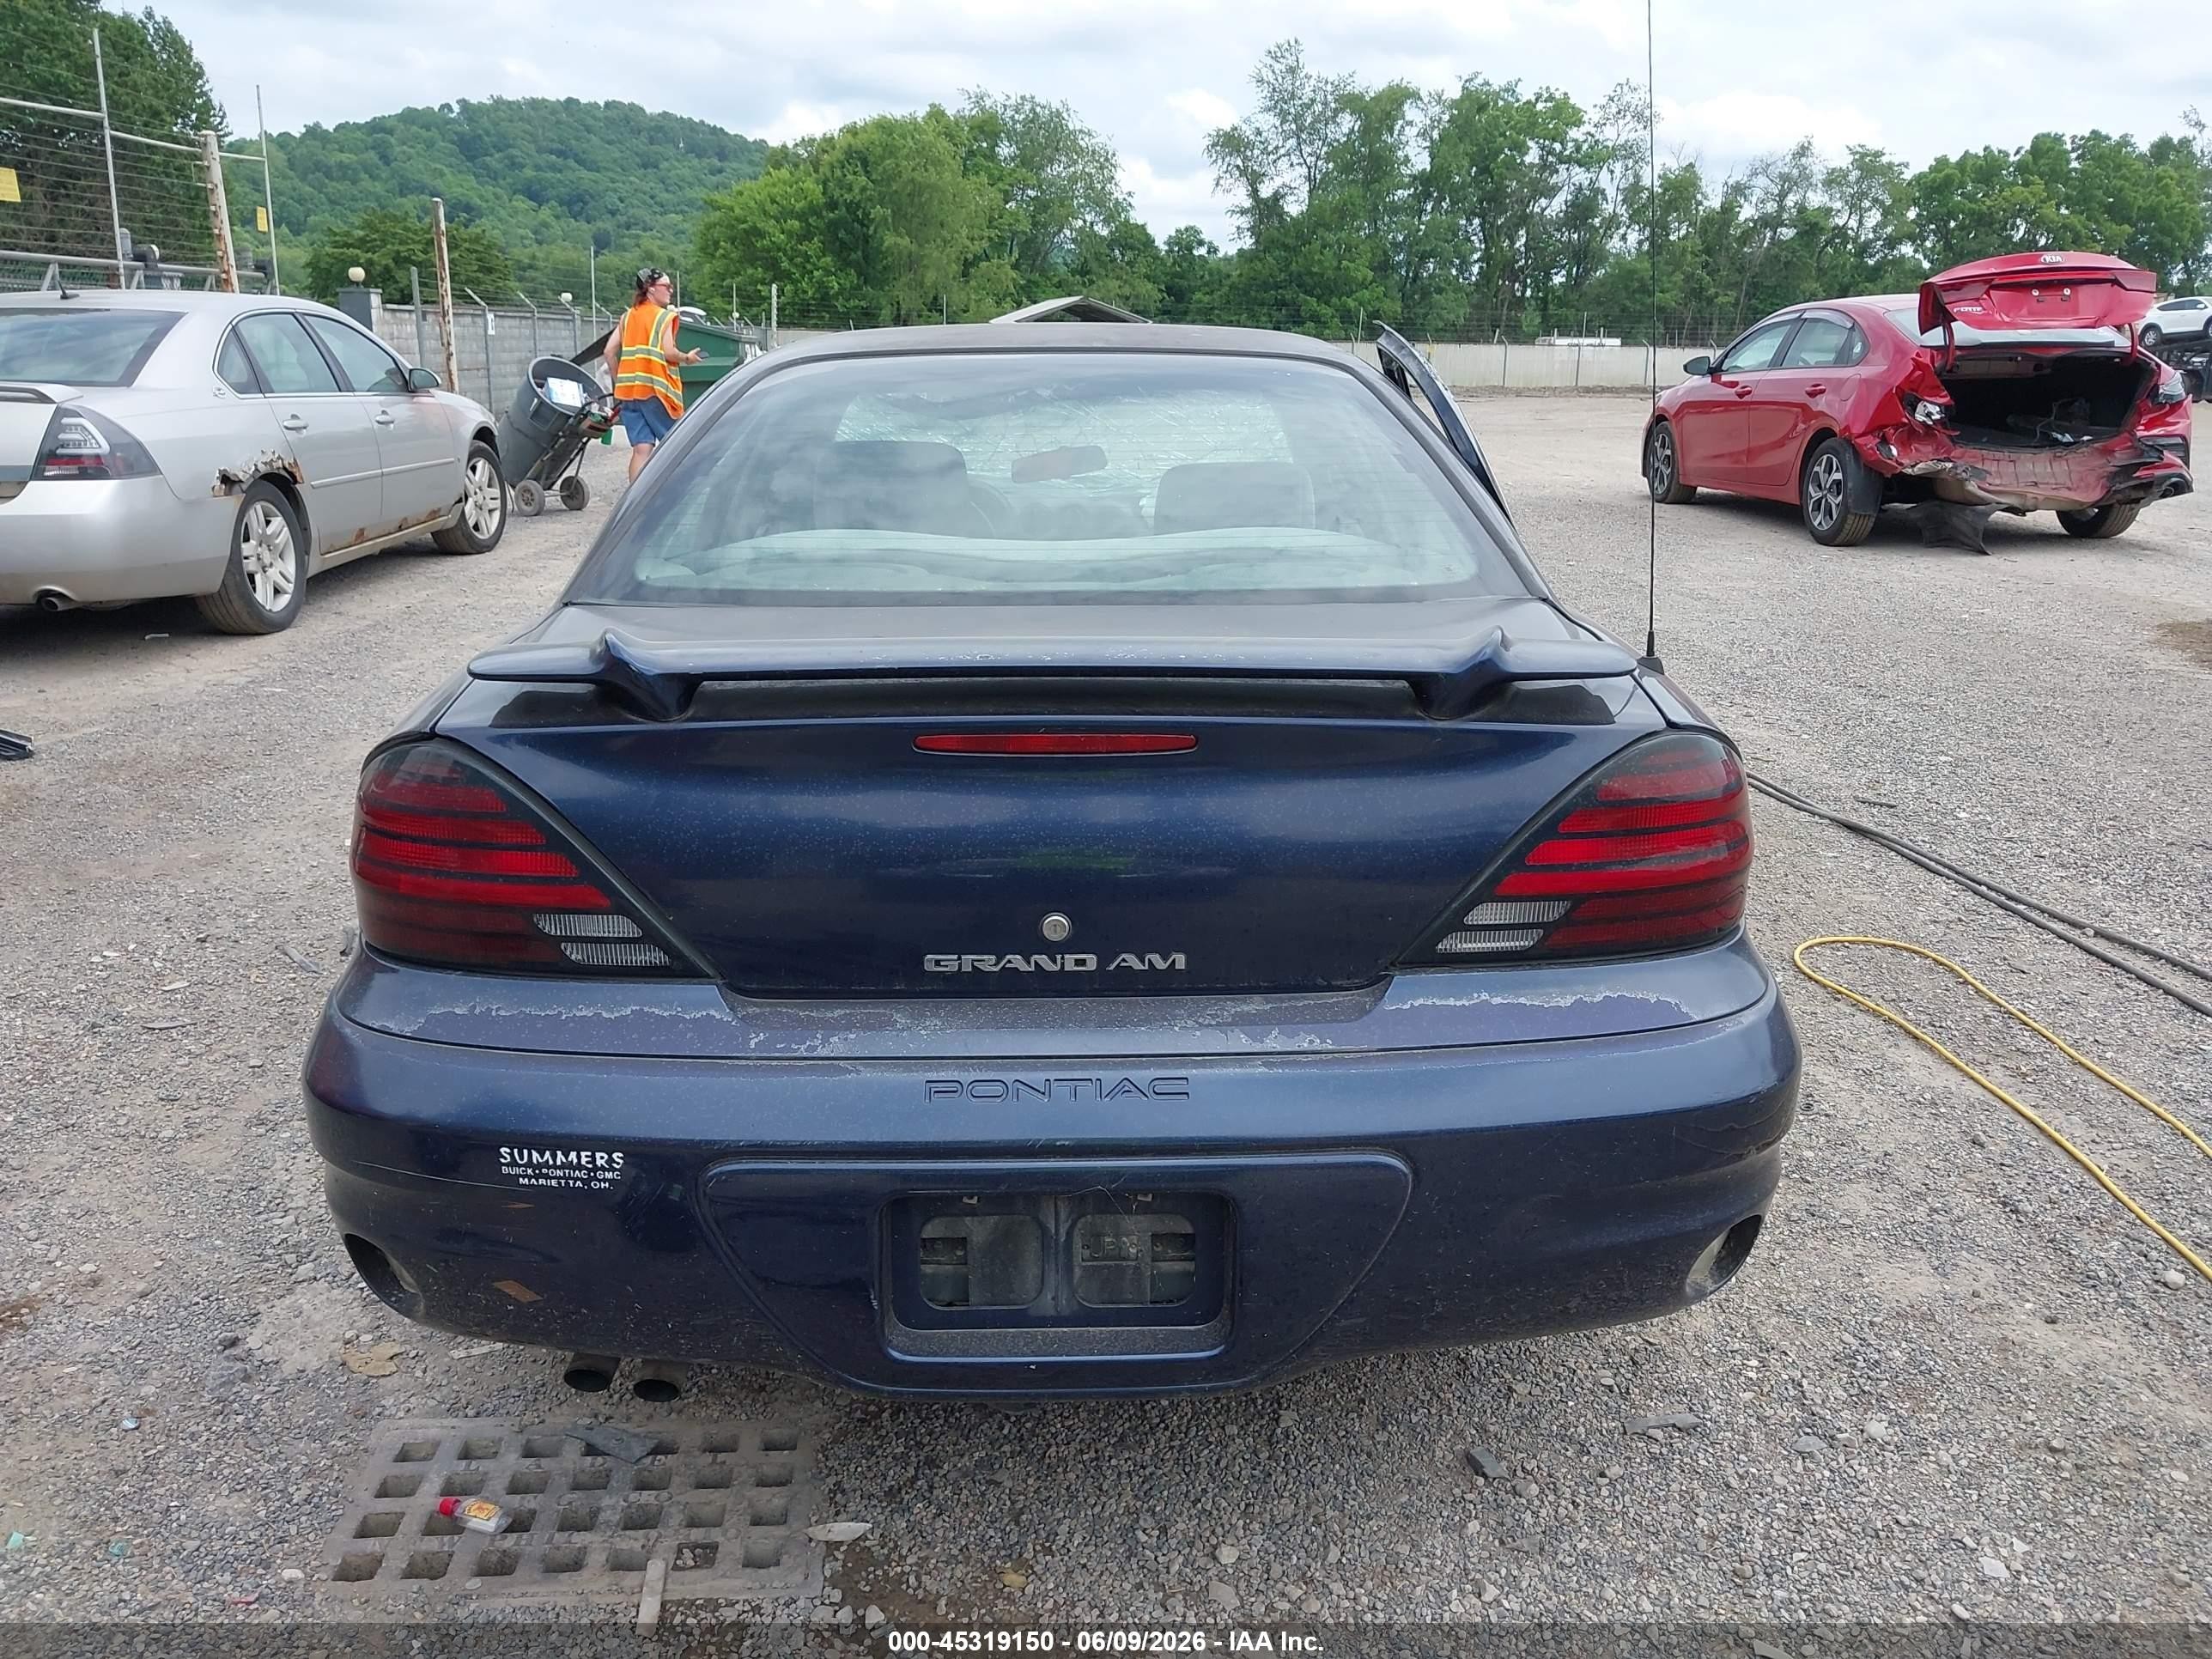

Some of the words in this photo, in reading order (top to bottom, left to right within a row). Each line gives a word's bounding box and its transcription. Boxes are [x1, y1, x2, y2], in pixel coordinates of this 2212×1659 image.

[923, 953, 1098, 973] GRAND
[1105, 952, 1188, 971] AM
[924, 1077, 1190, 1104] PONTIAC
[499, 1146, 624, 1169] SUMMERS
[519, 1177, 588, 1190] MARIETTA,
[590, 1181, 614, 1190] OH.
